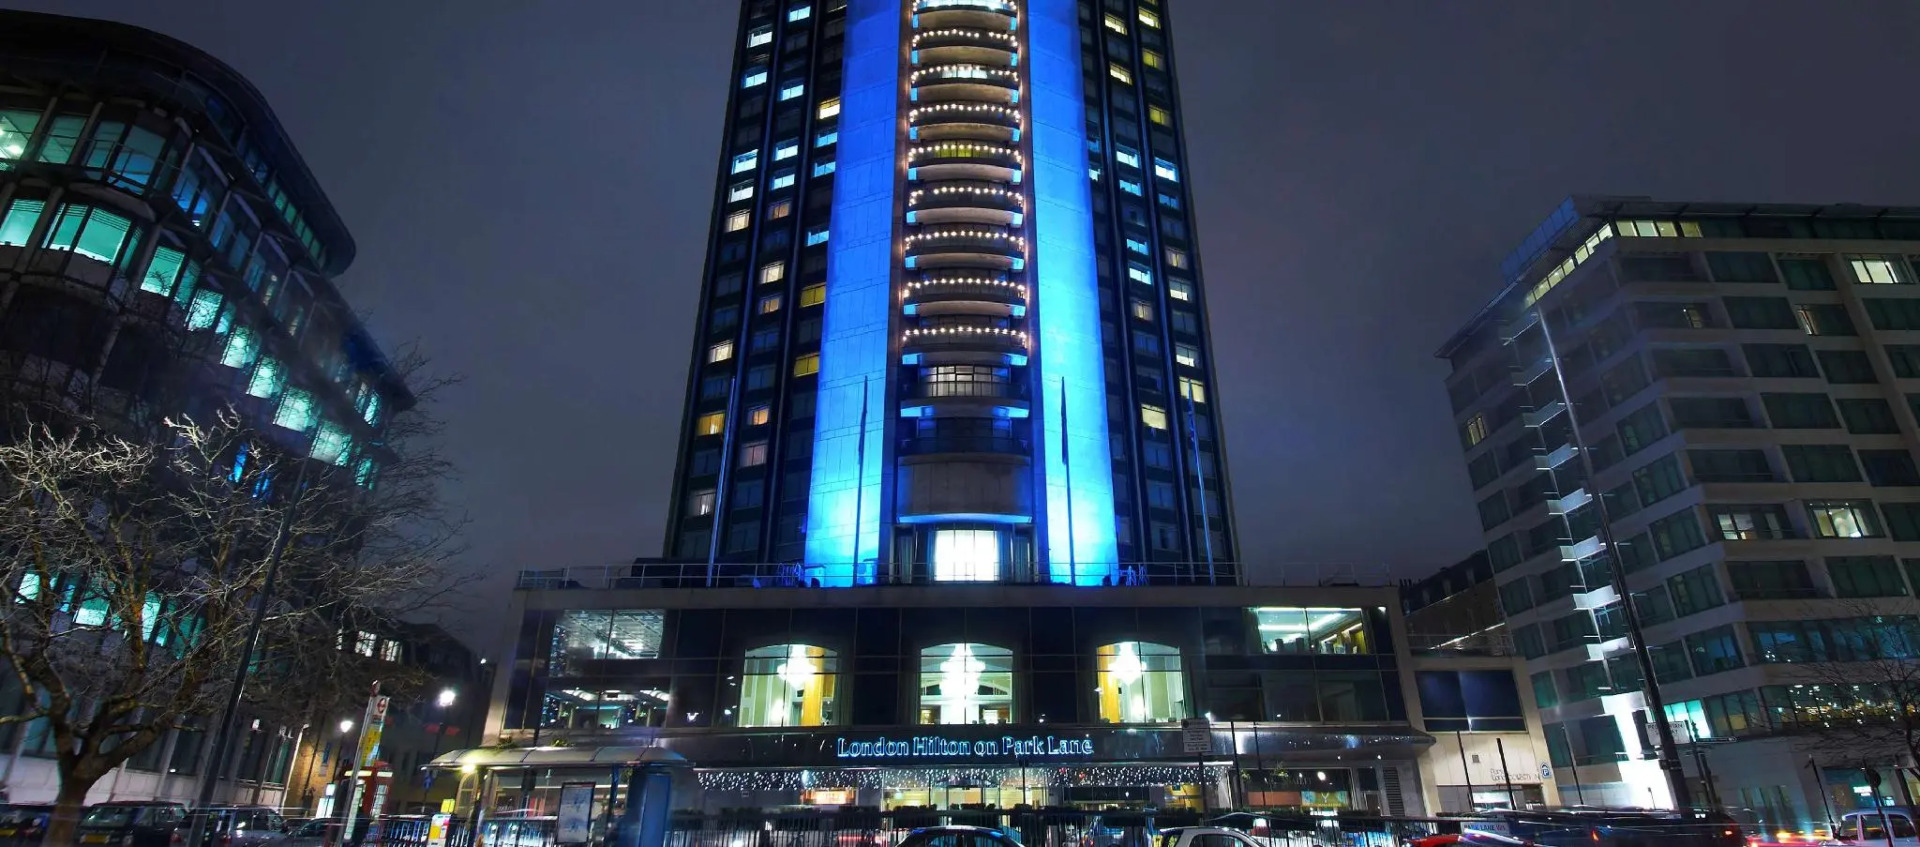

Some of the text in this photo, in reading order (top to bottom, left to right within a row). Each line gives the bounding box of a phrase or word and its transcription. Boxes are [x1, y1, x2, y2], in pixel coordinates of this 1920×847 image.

[837, 736, 1095, 757] London Hilton on Park Lane
